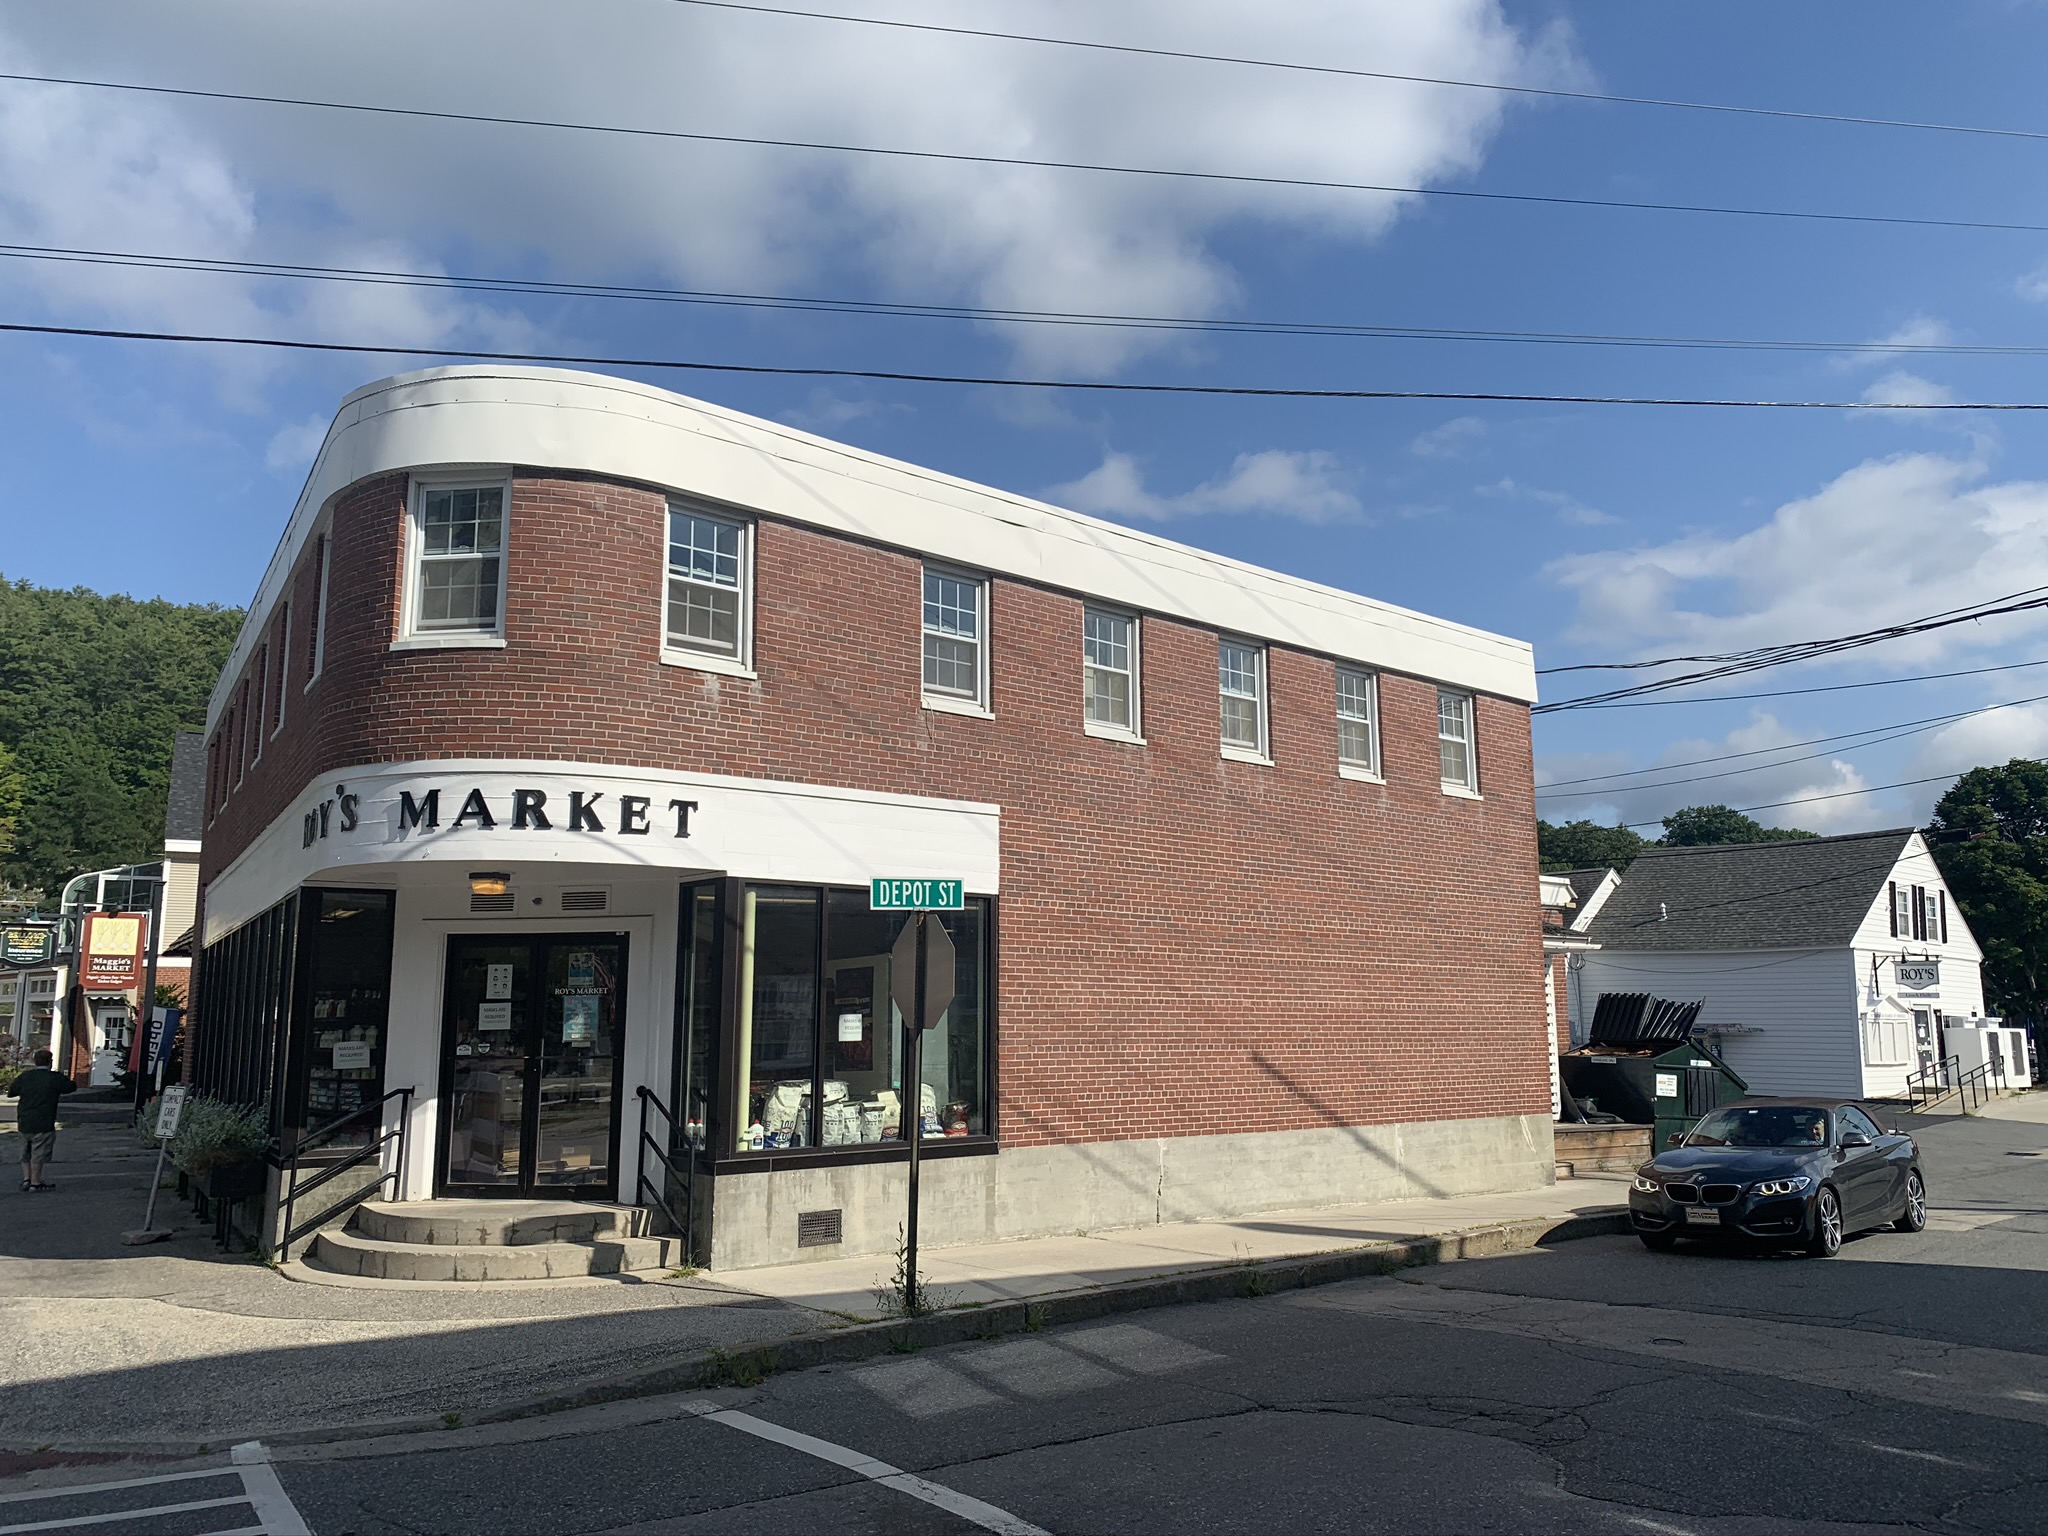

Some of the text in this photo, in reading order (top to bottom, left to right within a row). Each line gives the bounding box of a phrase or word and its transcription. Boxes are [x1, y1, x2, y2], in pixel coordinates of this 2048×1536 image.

[398, 788, 699, 838] MARKET
[879, 880, 956, 906] DEPOT ST
[93, 957, 131, 966] Maggie's
[1900, 968, 1935, 980] ROY'S
[576, 987, 609, 995] MARKET
